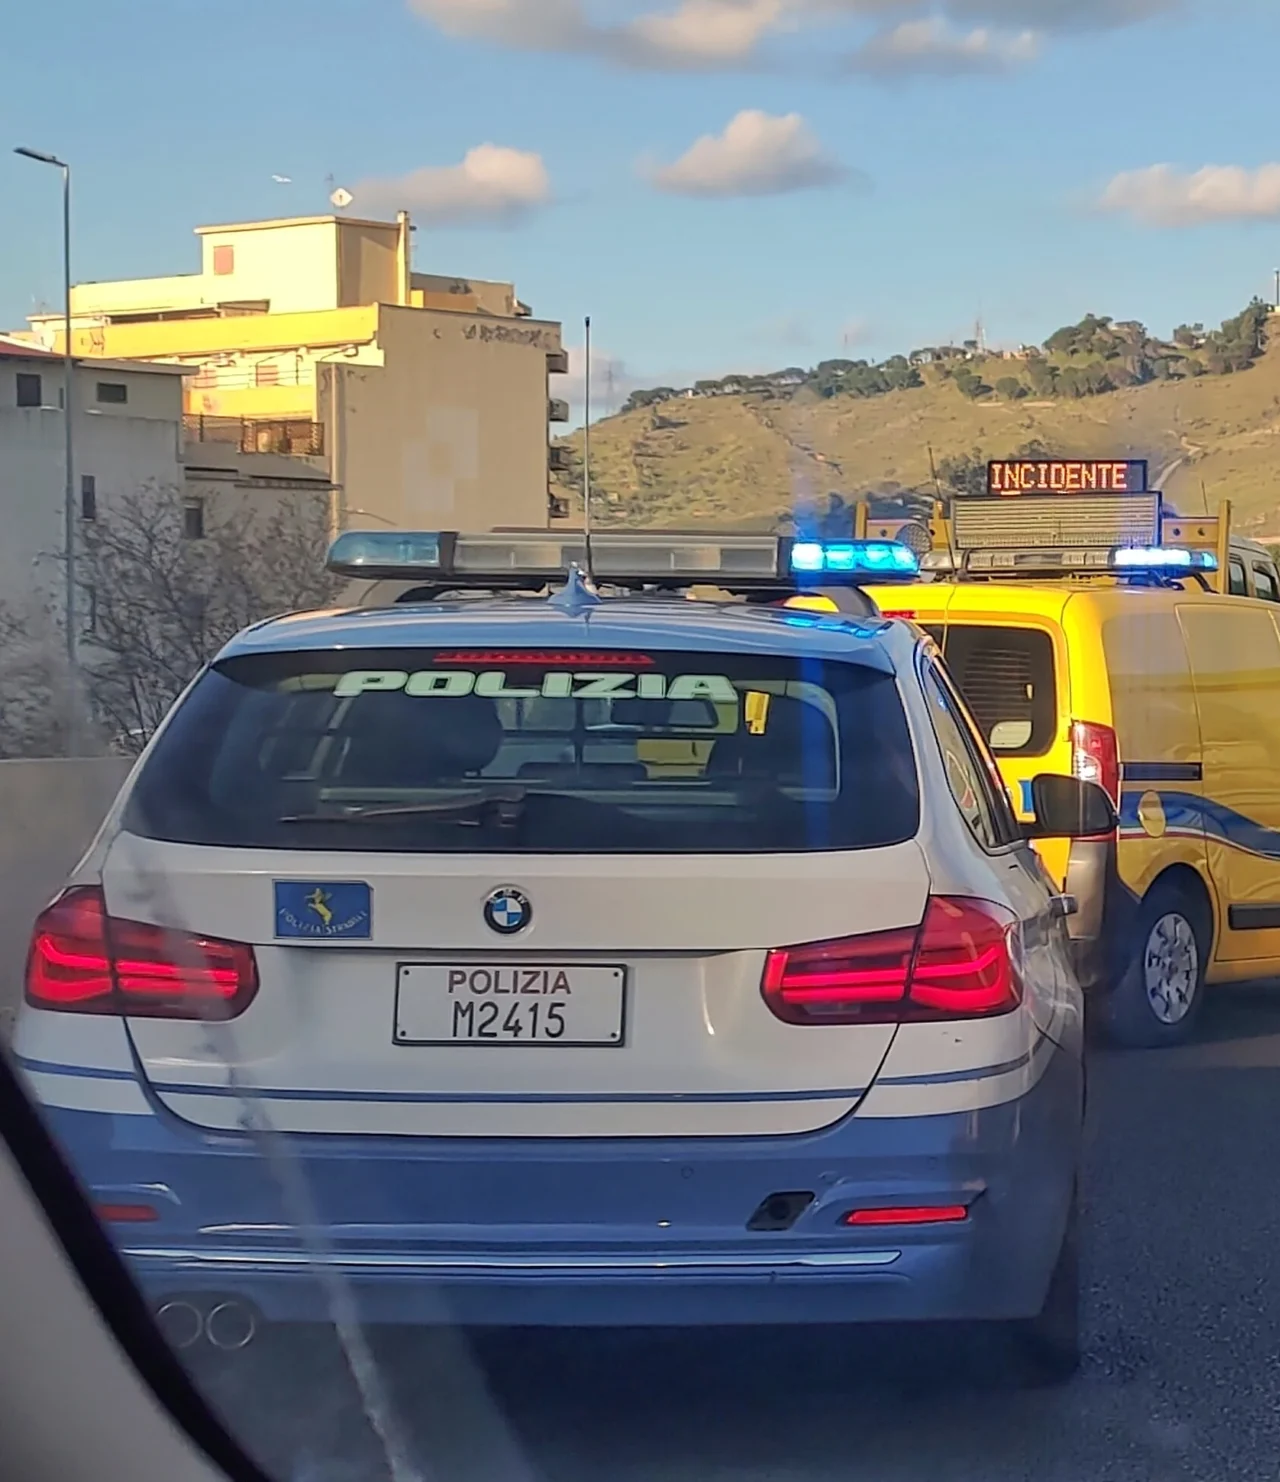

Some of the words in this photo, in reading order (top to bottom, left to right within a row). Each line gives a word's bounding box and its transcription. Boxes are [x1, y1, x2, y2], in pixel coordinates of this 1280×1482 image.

[990, 463, 1127, 489] INCIDENTE
[331, 670, 739, 700] POLIZIA
[448, 969, 572, 995] POLIZIA
[452, 1000, 567, 1039] M2415
